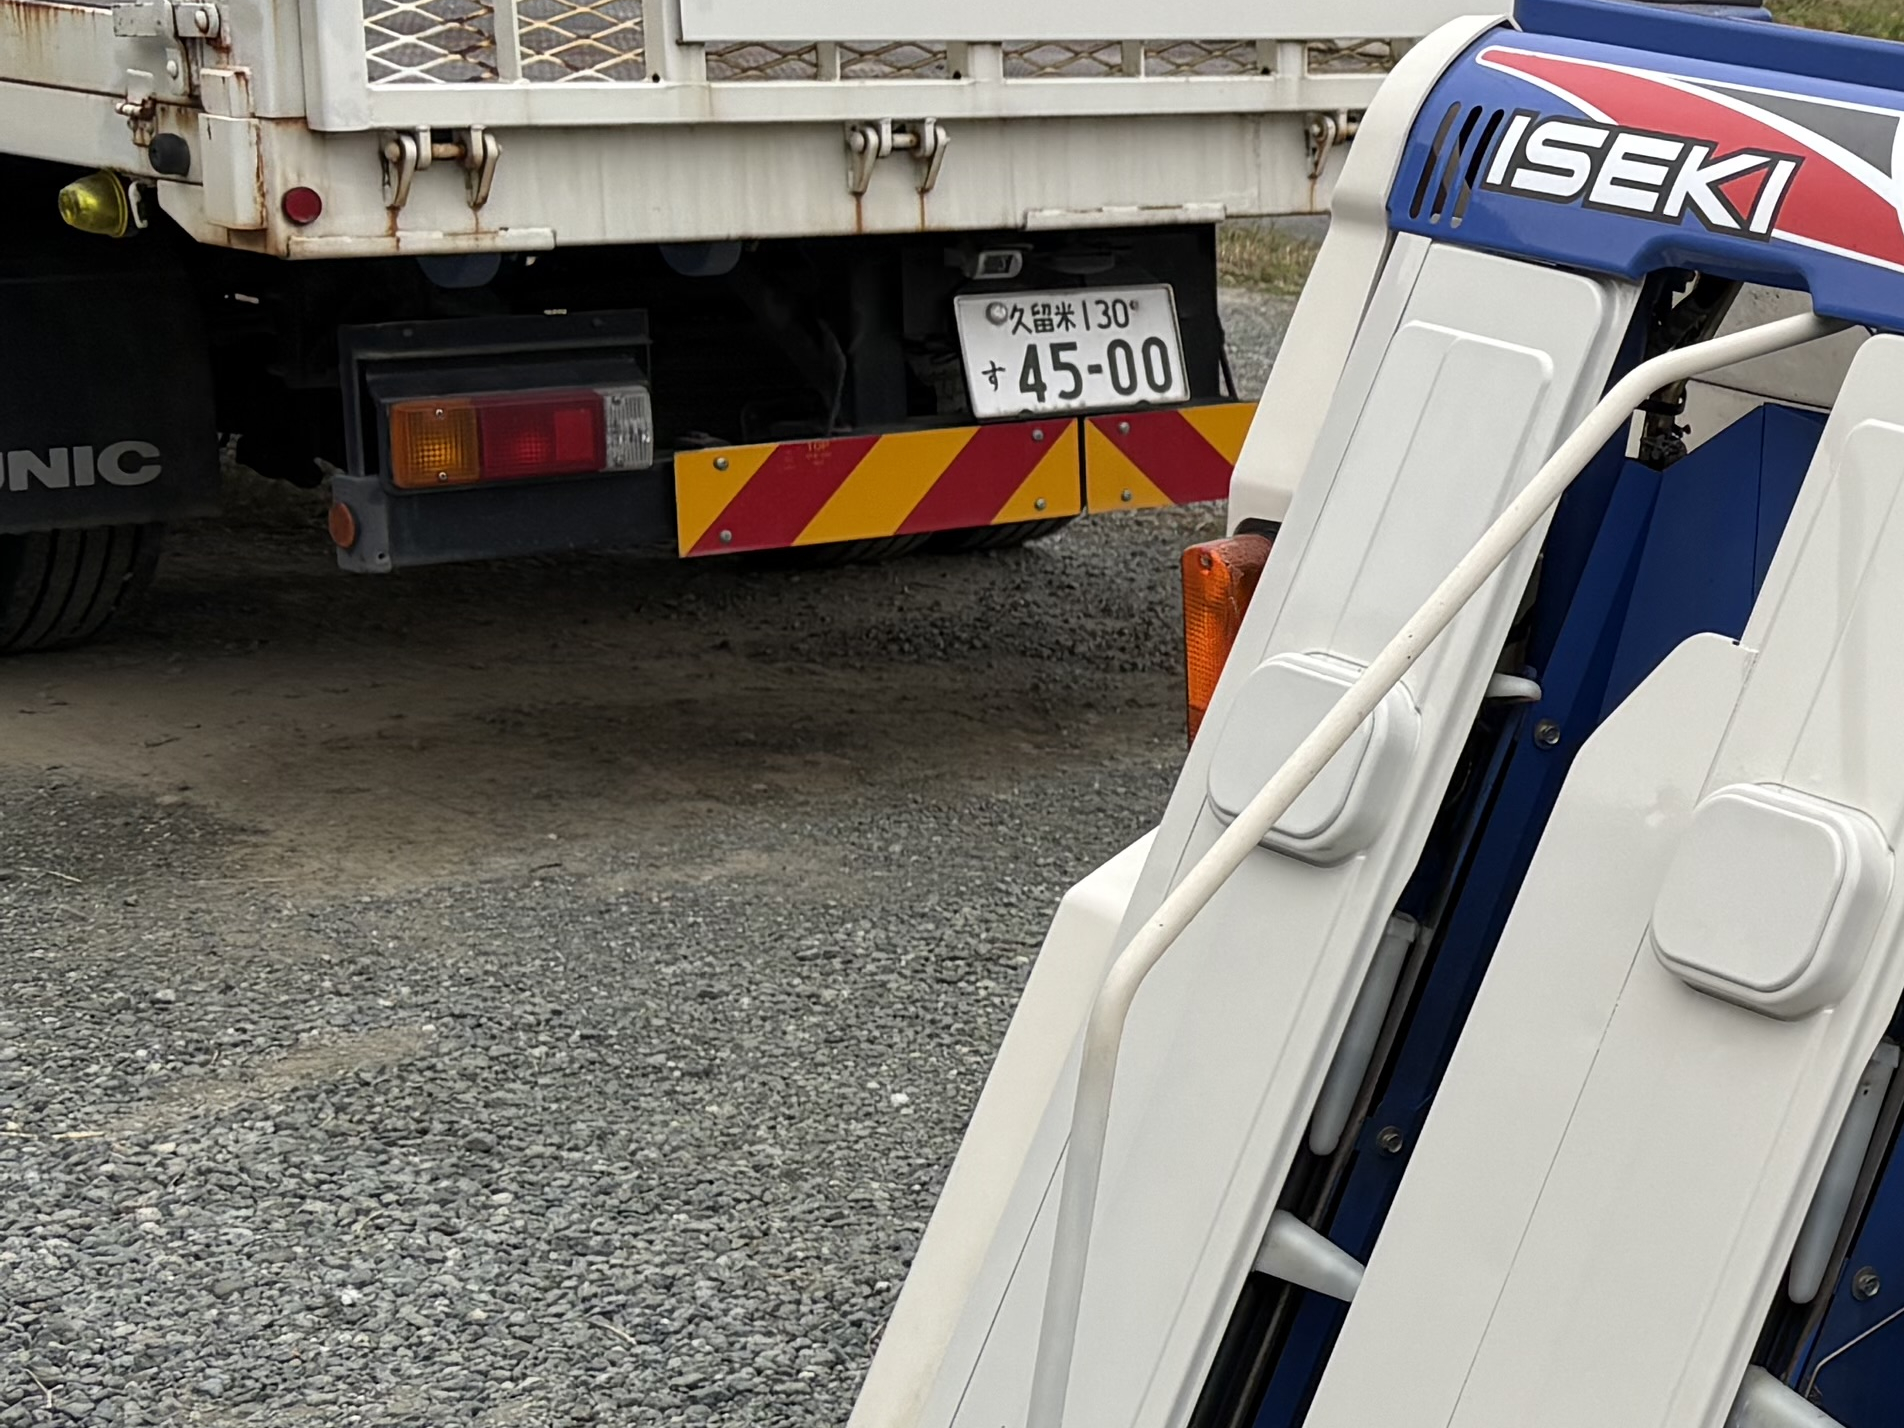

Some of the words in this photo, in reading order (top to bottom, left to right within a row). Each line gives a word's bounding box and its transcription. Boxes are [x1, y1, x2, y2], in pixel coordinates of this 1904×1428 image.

[1489, 112, 1798, 234] ISEKI
[981, 360, 1006, 392] す
[1019, 336, 1173, 403] 45-00
[0, 441, 162, 492] NIC
